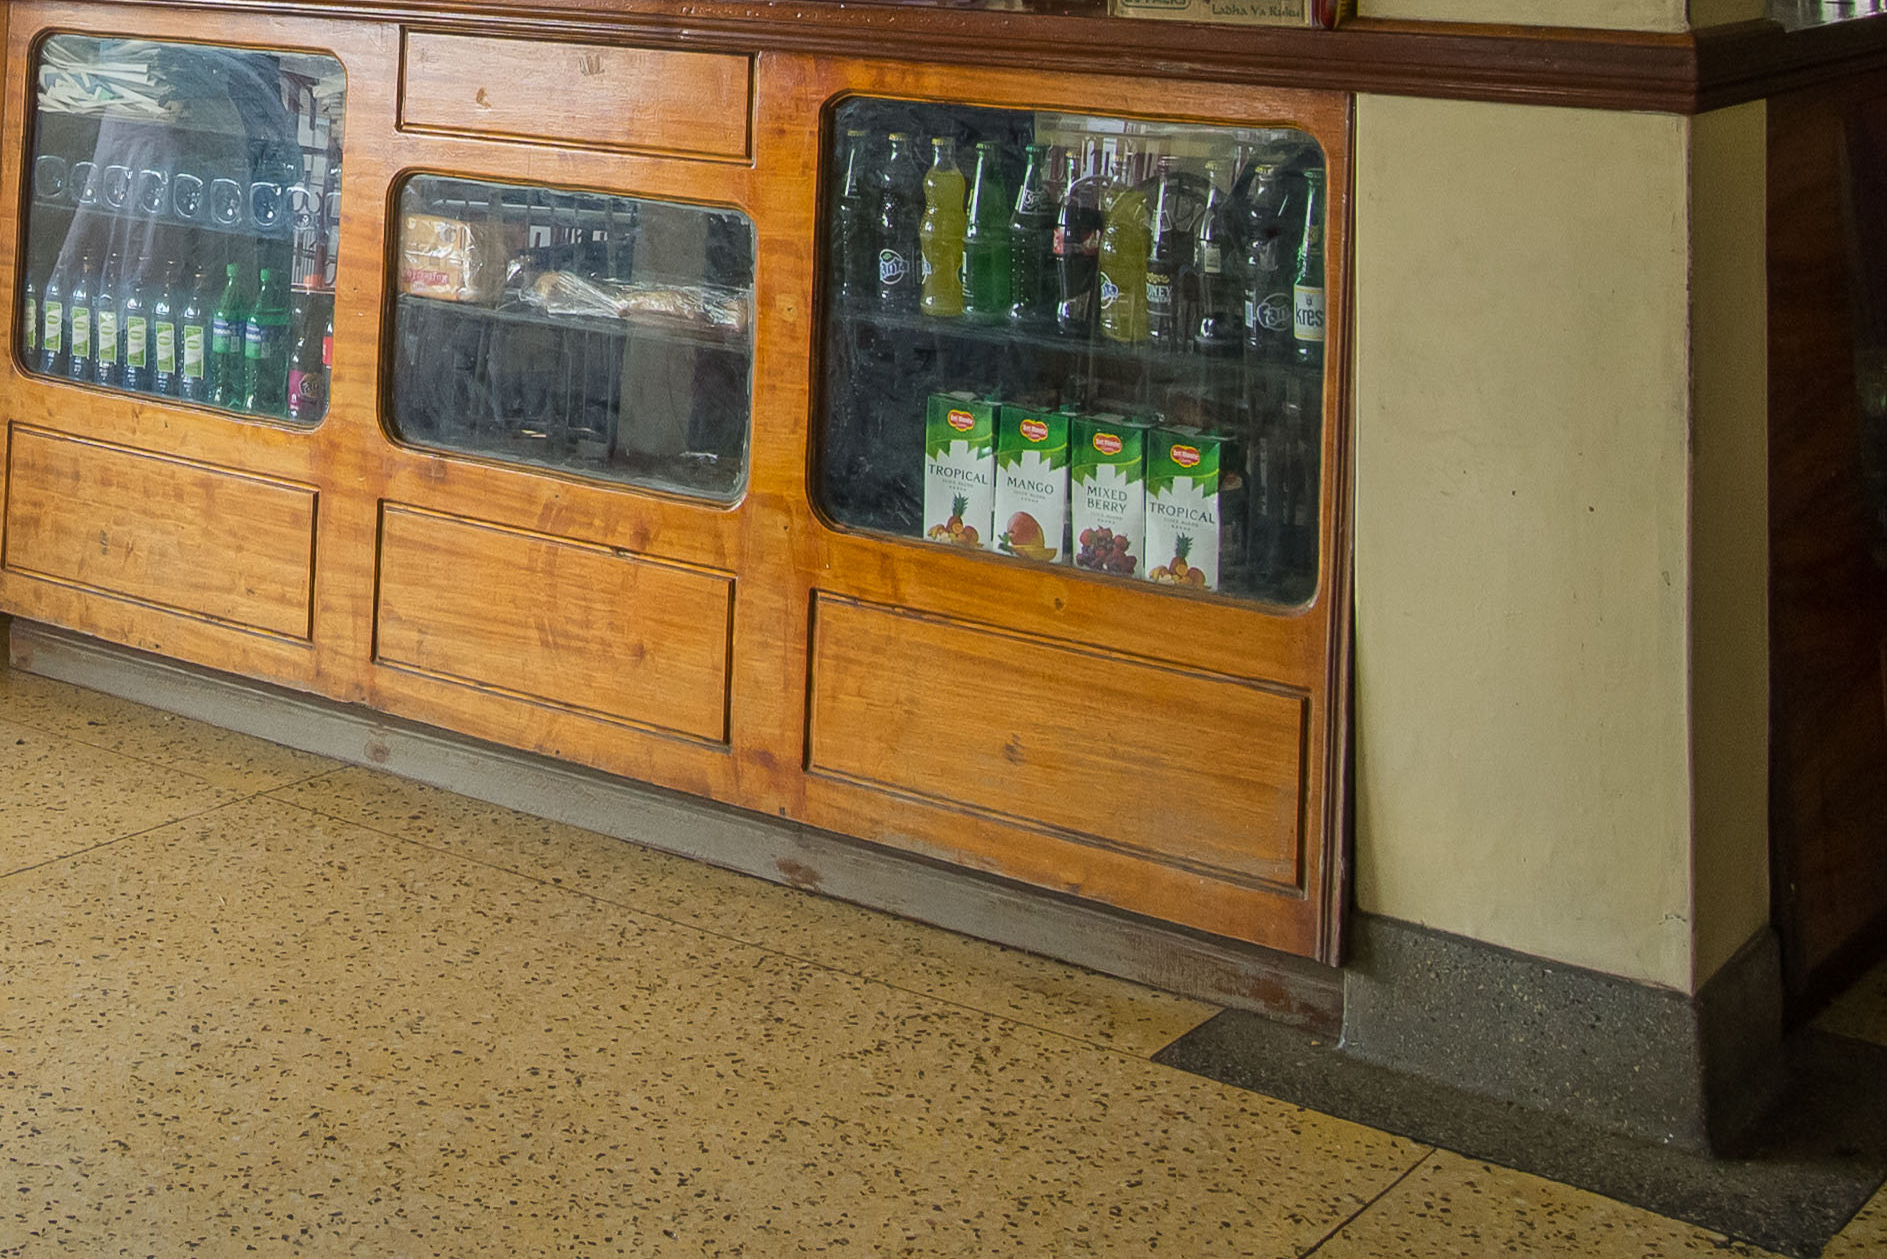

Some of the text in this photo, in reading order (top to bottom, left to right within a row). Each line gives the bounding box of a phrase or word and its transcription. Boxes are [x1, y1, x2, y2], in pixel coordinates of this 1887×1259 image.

[1295, 304, 1324, 327] kres
[928, 463, 989, 485] TROPICAL
[1007, 476, 1054, 495] MANGO
[1087, 485, 1128, 502] MIXED
[1087, 498, 1127, 514] BERRY
[1149, 501, 1216, 524] TROPICAL
